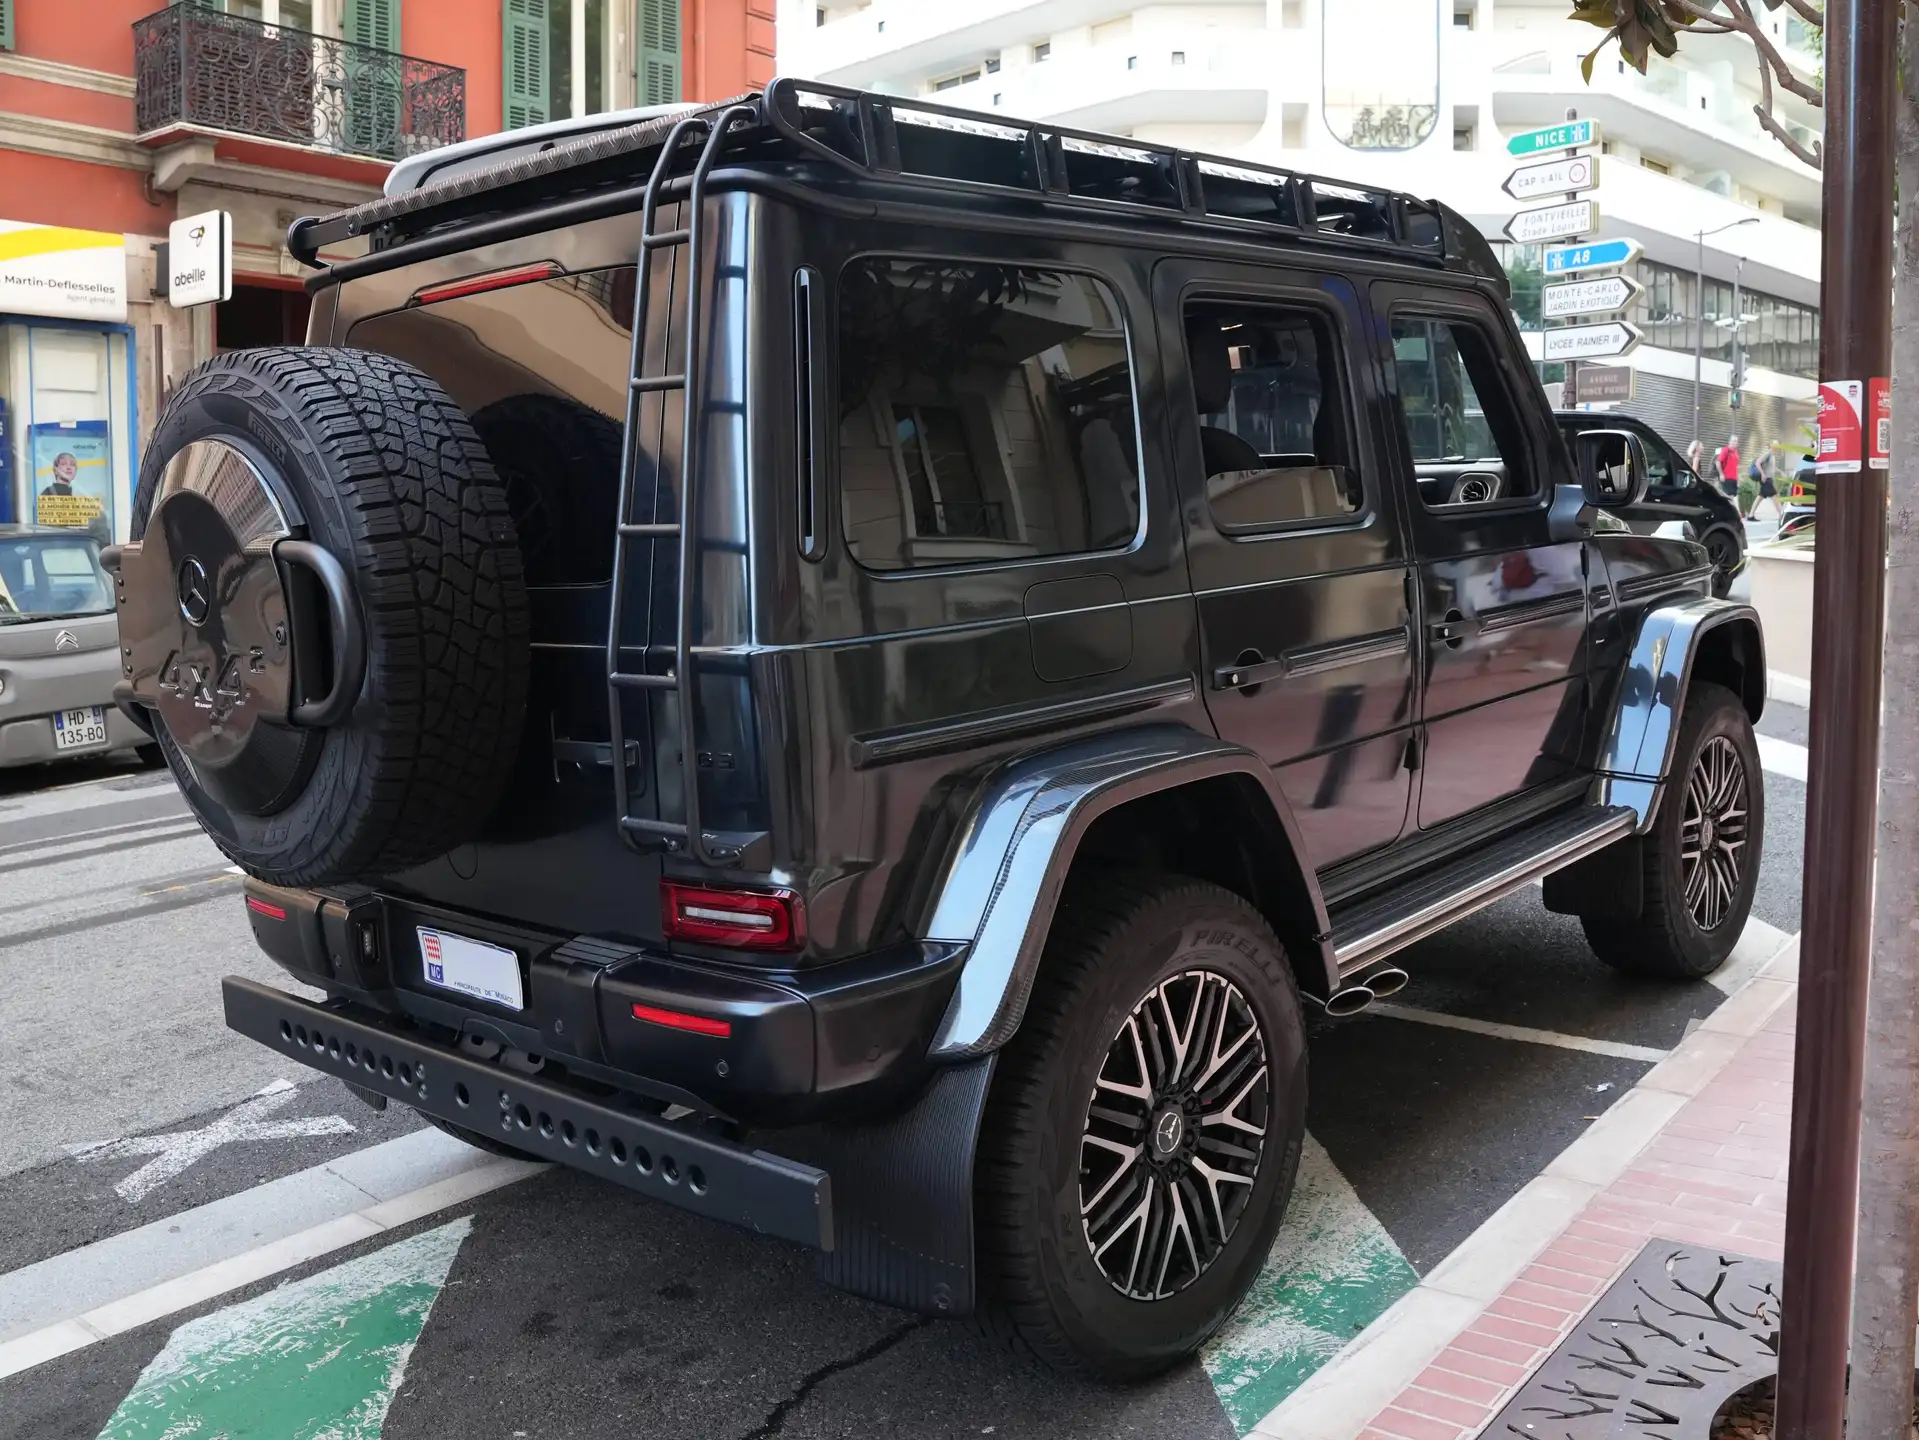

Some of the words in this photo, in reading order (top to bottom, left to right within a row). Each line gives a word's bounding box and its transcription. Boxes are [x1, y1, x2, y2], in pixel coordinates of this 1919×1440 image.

[1535, 129, 1566, 148] NICE
[1518, 176, 1536, 188] CAP
[1524, 205, 1587, 225] FONTVIEILLE
[1521, 224, 1547, 238] Stade
[1552, 218, 1576, 233] Louis
[1572, 248, 1591, 265] A8
[4, 274, 116, 294] Martin-Deflesselles
[174, 267, 206, 287] abeille
[1548, 282, 1621, 301] MONTE-CARLO
[1548, 300, 1578, 313] JARDIN
[1580, 294, 1621, 309] EXOTIQUE
[1576, 334, 1610, 348] RAINIER
[1612, 333, 1621, 344] III
[59, 725, 104, 745] 135-BQ
[1189, 929, 1281, 985] PIRELLI
[430, 963, 442, 980] MC
[484, 989, 493, 997] DE
